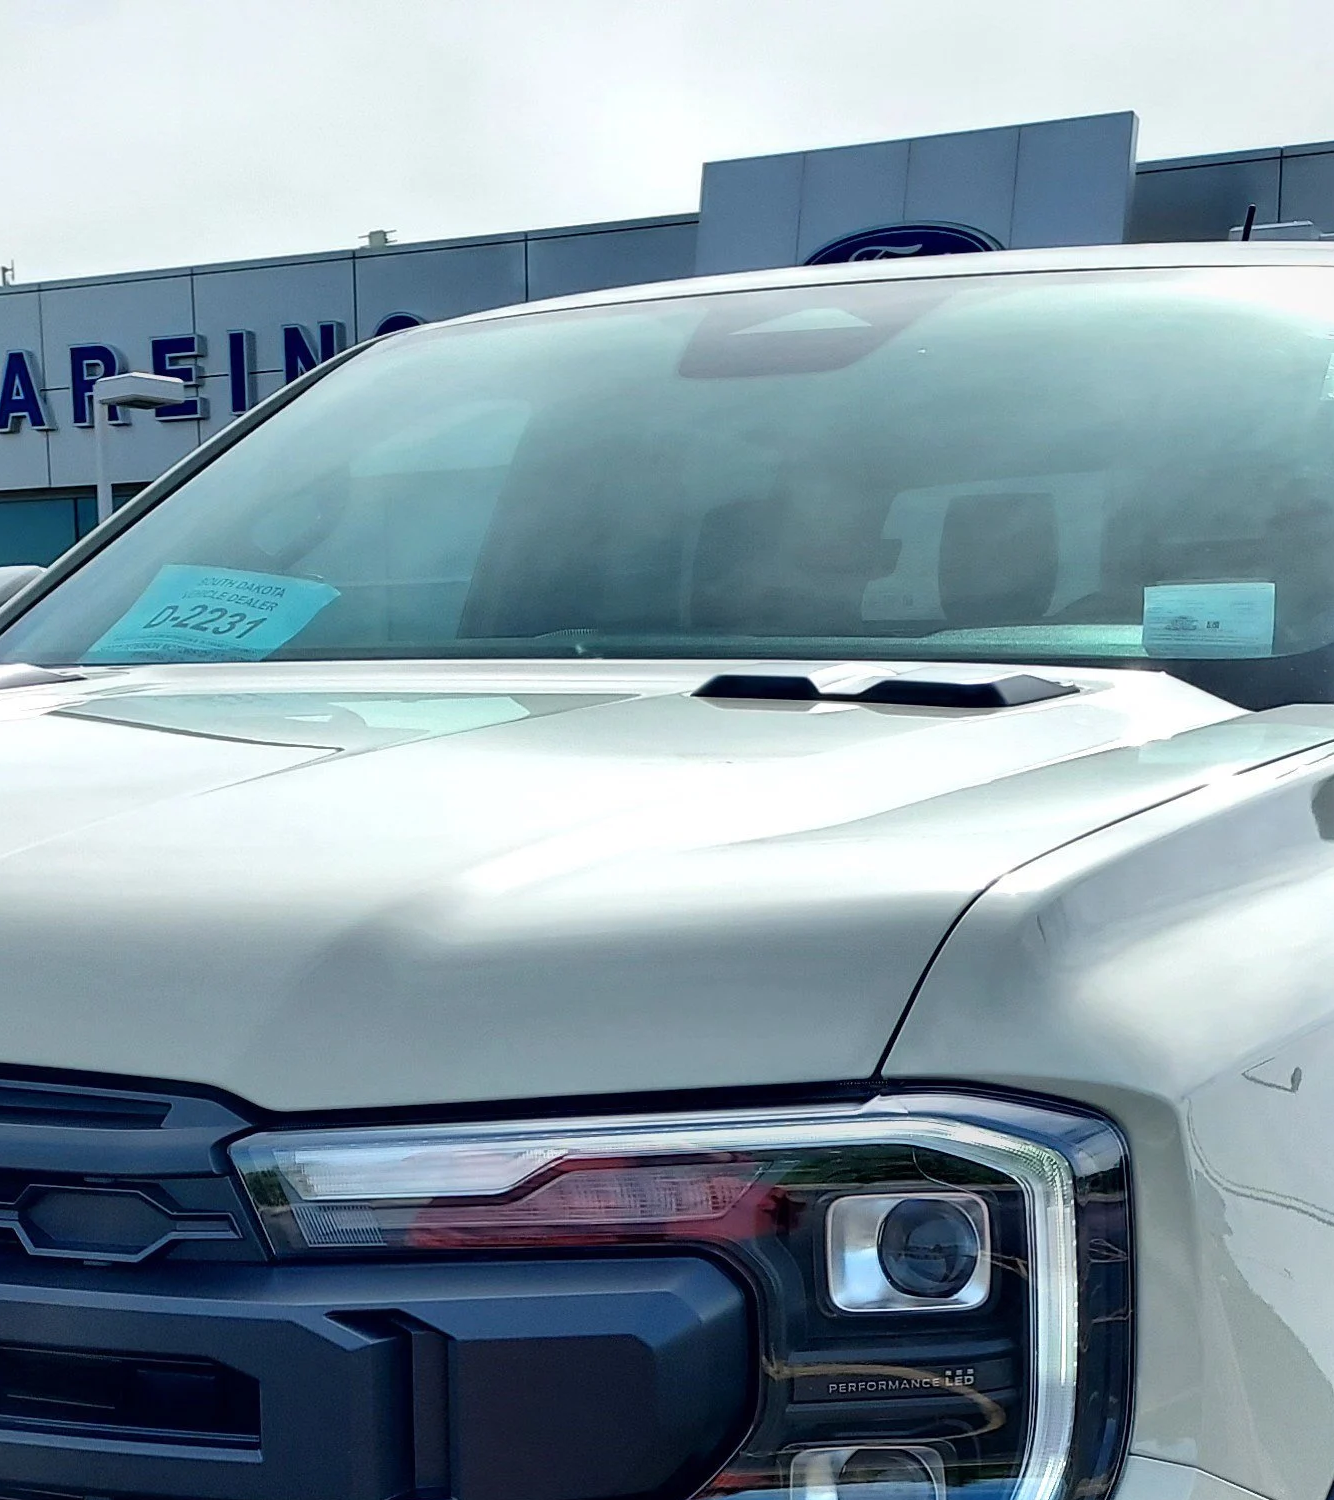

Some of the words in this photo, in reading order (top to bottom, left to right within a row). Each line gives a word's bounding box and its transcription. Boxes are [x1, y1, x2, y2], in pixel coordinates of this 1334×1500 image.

[236, 581, 286, 598] DAKOTA
[227, 593, 278, 611] DEALER
[142, 604, 268, 639] D-2231
[828, 1377, 940, 1394] PERFORMANCE
[945, 1375, 975, 1387] LED
